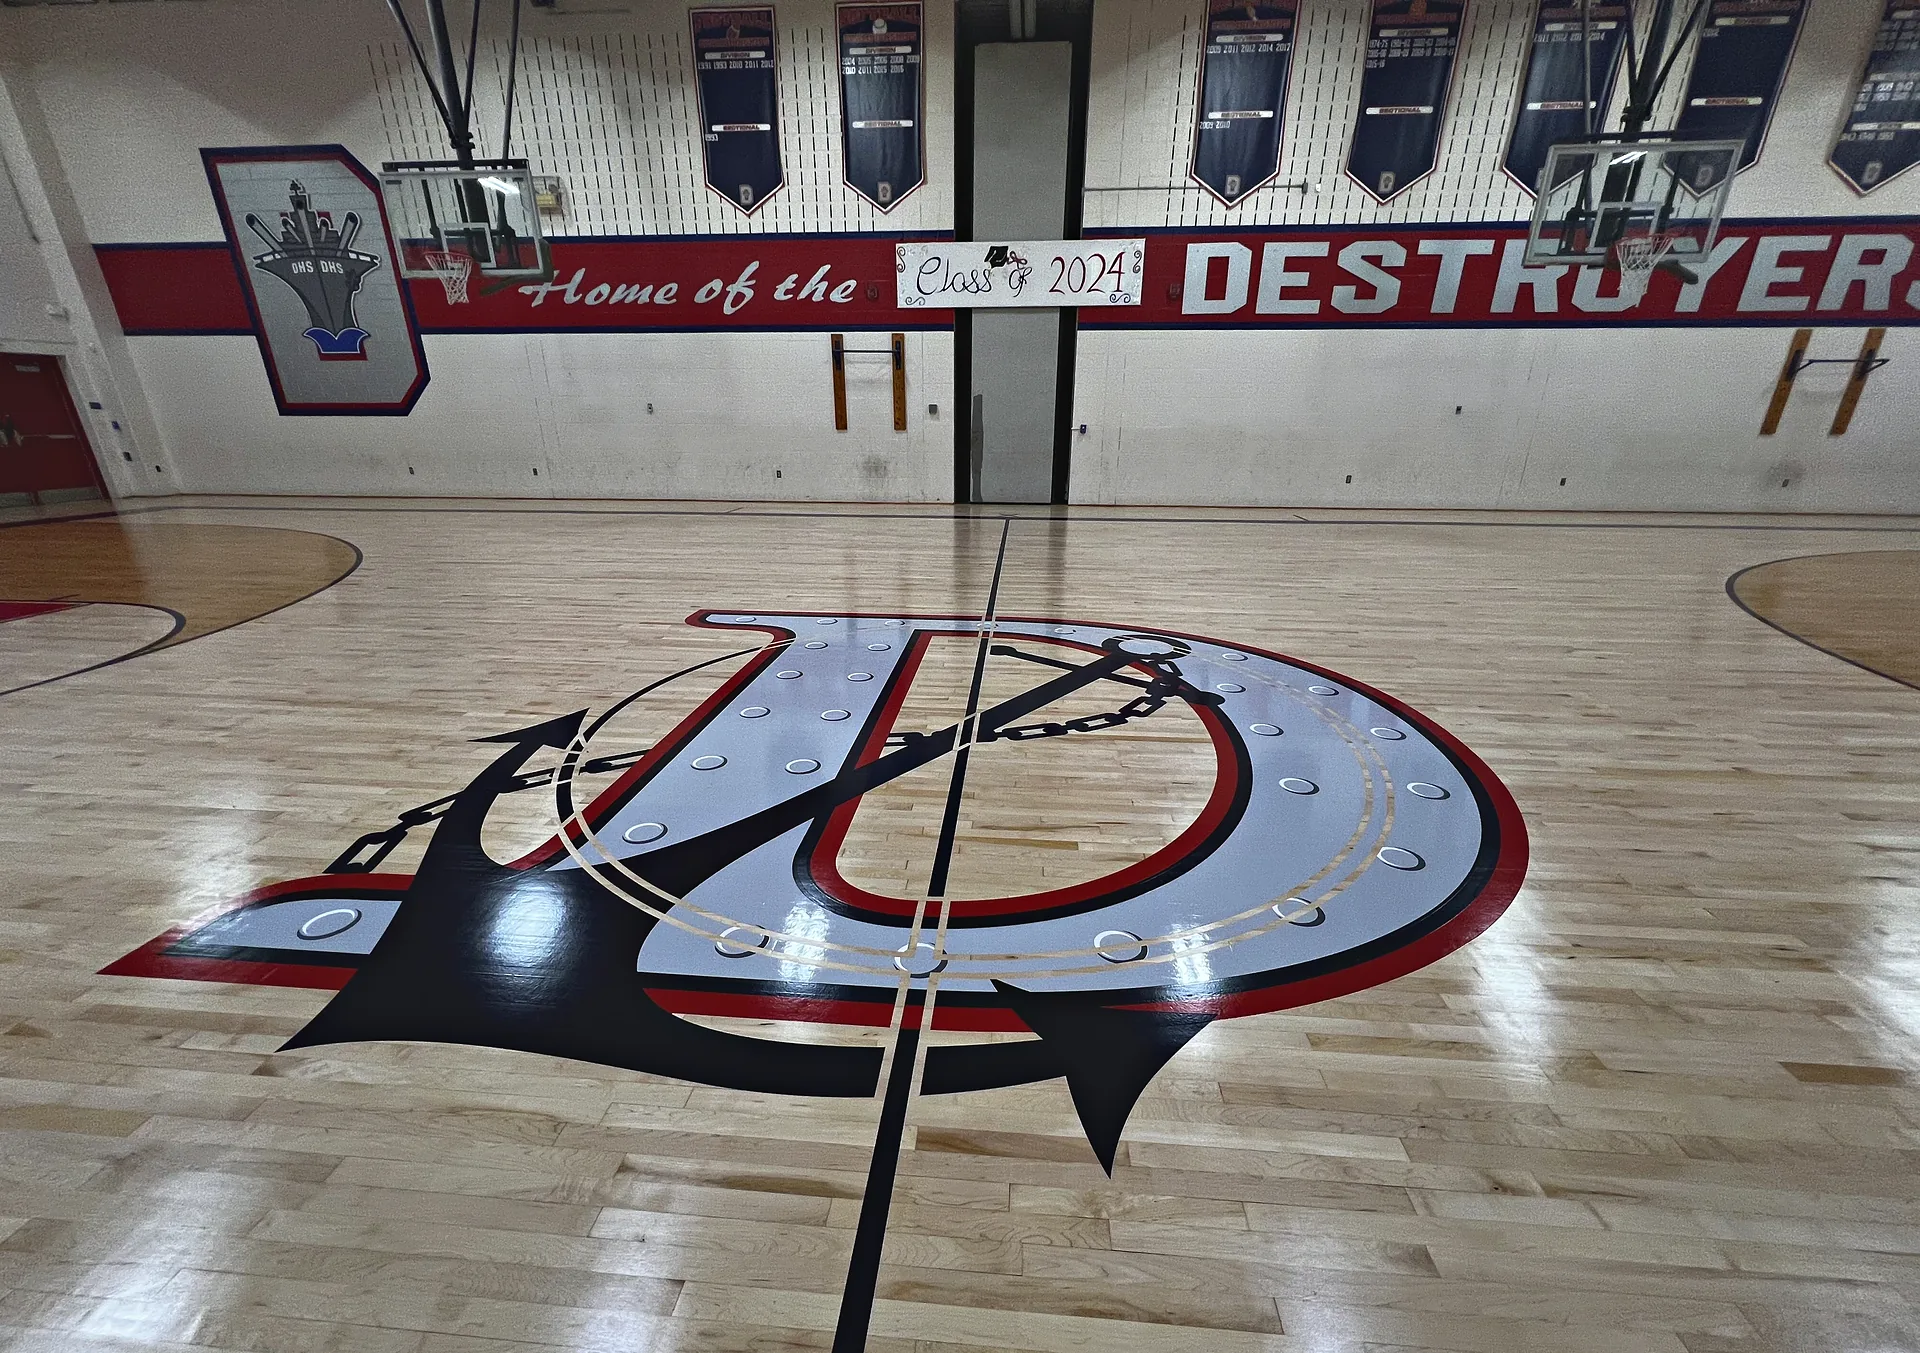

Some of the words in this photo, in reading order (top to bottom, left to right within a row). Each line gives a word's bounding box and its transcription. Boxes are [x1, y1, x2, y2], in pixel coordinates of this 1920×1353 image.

[1223, 44, 1239, 53] 2011
[1258, 43, 1274, 52] 2014
[744, 60, 759, 68] 2011
[857, 66, 872, 75] 2011
[1379, 106, 1422, 114] SECTIONAL
[320, 259, 344, 275] DHS
[916, 255, 992, 296] Class
[1008, 265, 1033, 298] of
[1048, 251, 1126, 295] 2024
[1181, 233, 1920, 315] DESTROYER
[517, 267, 679, 308] Home
[693, 260, 760, 315] of
[773, 264, 858, 303] the
